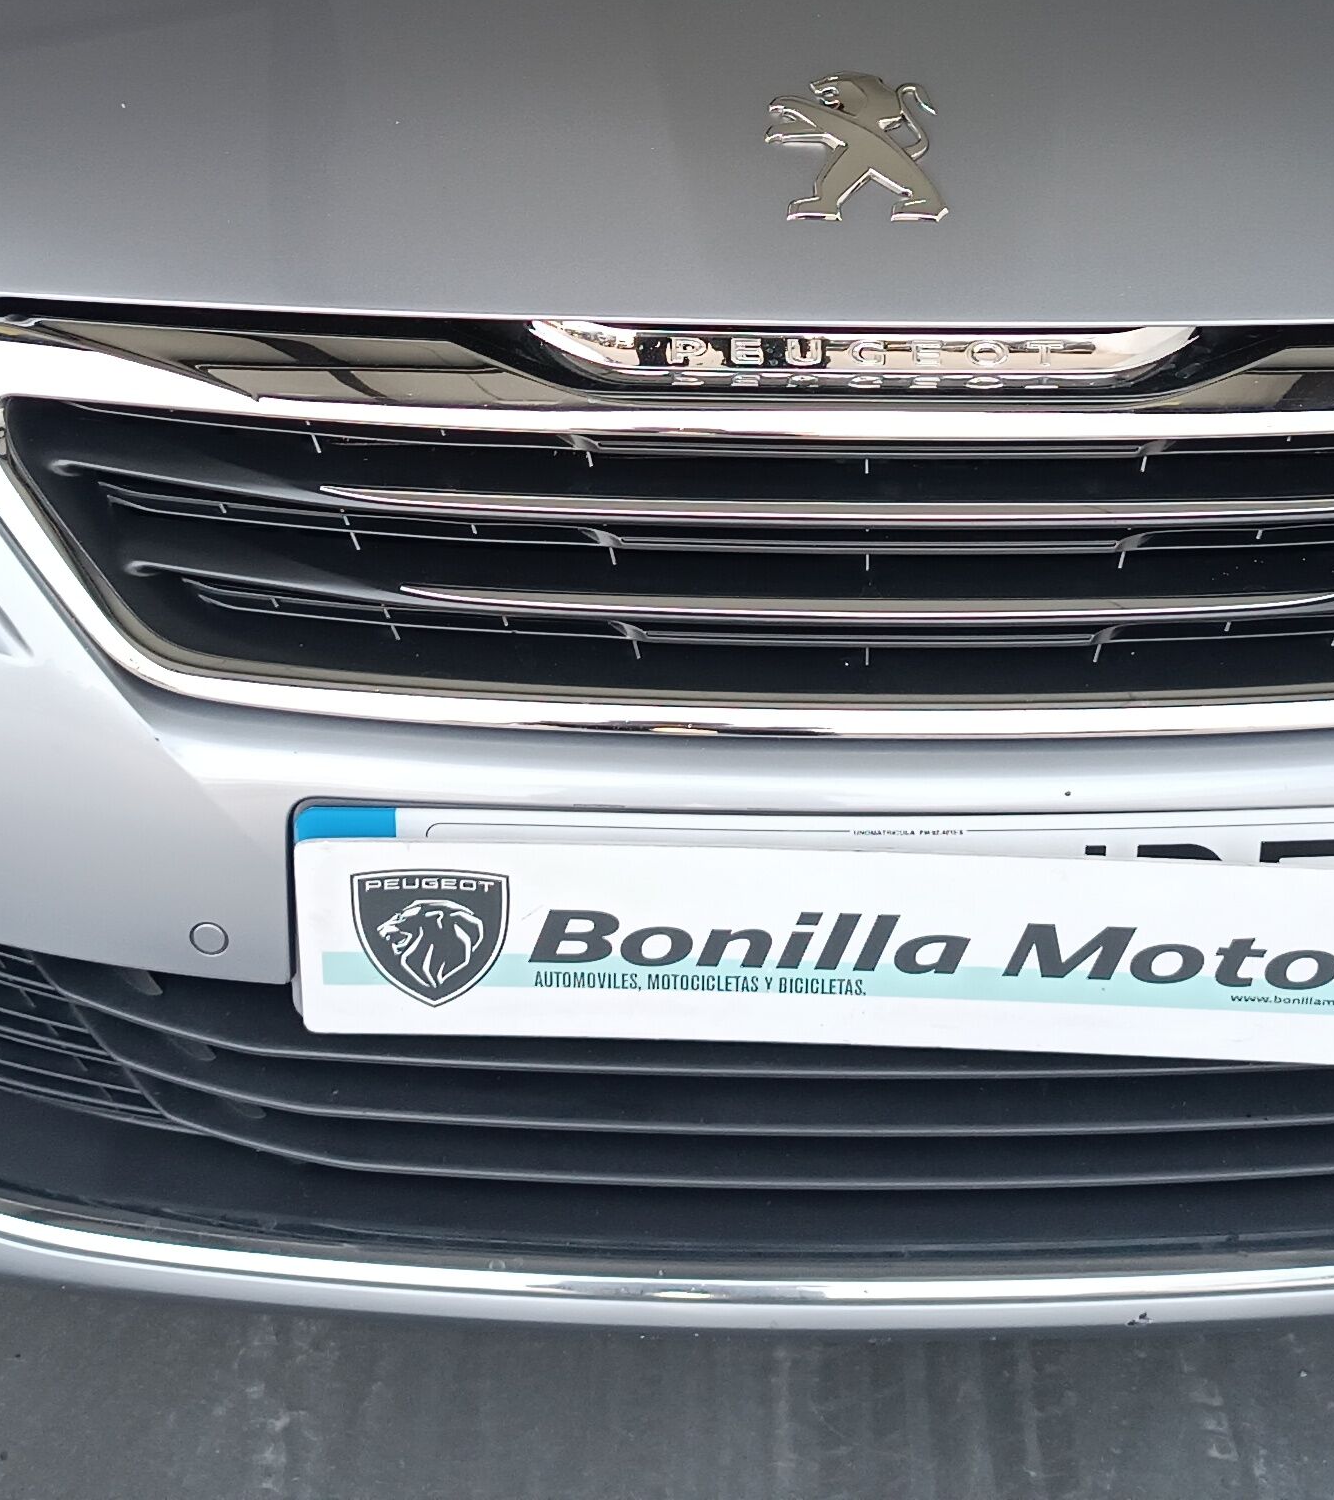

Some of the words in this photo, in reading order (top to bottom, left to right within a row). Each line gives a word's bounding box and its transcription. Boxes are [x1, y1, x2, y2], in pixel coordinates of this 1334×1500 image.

[667, 336, 1066, 367] PEUGEOT
[366, 878, 494, 892] PEUGEOT
[528, 909, 971, 975] Bonilla
[534, 971, 641, 991] AUTOMOVILES,
[648, 974, 758, 992] MOTOCICLETAS
[763, 976, 774, 991] Y
[779, 977, 866, 996] BICICLETAS.
